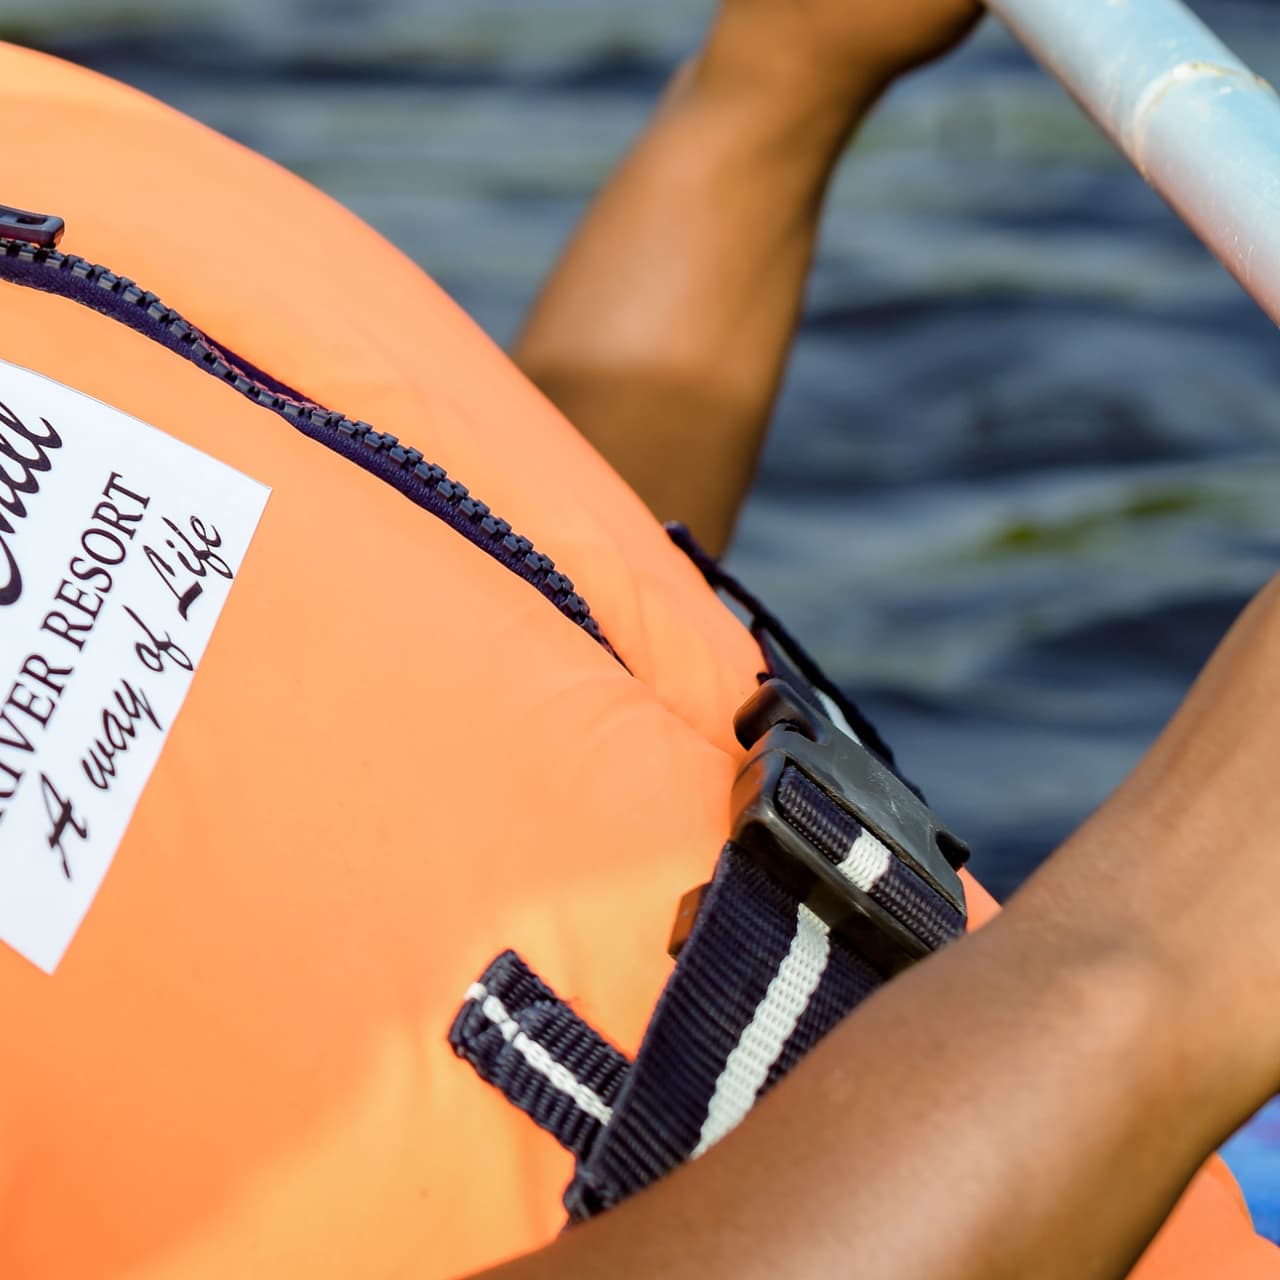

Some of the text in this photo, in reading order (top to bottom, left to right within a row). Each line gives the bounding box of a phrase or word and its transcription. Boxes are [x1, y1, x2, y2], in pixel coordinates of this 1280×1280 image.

[40, 515, 234, 880] A way of Life
[41, 471, 151, 652] RESORT
